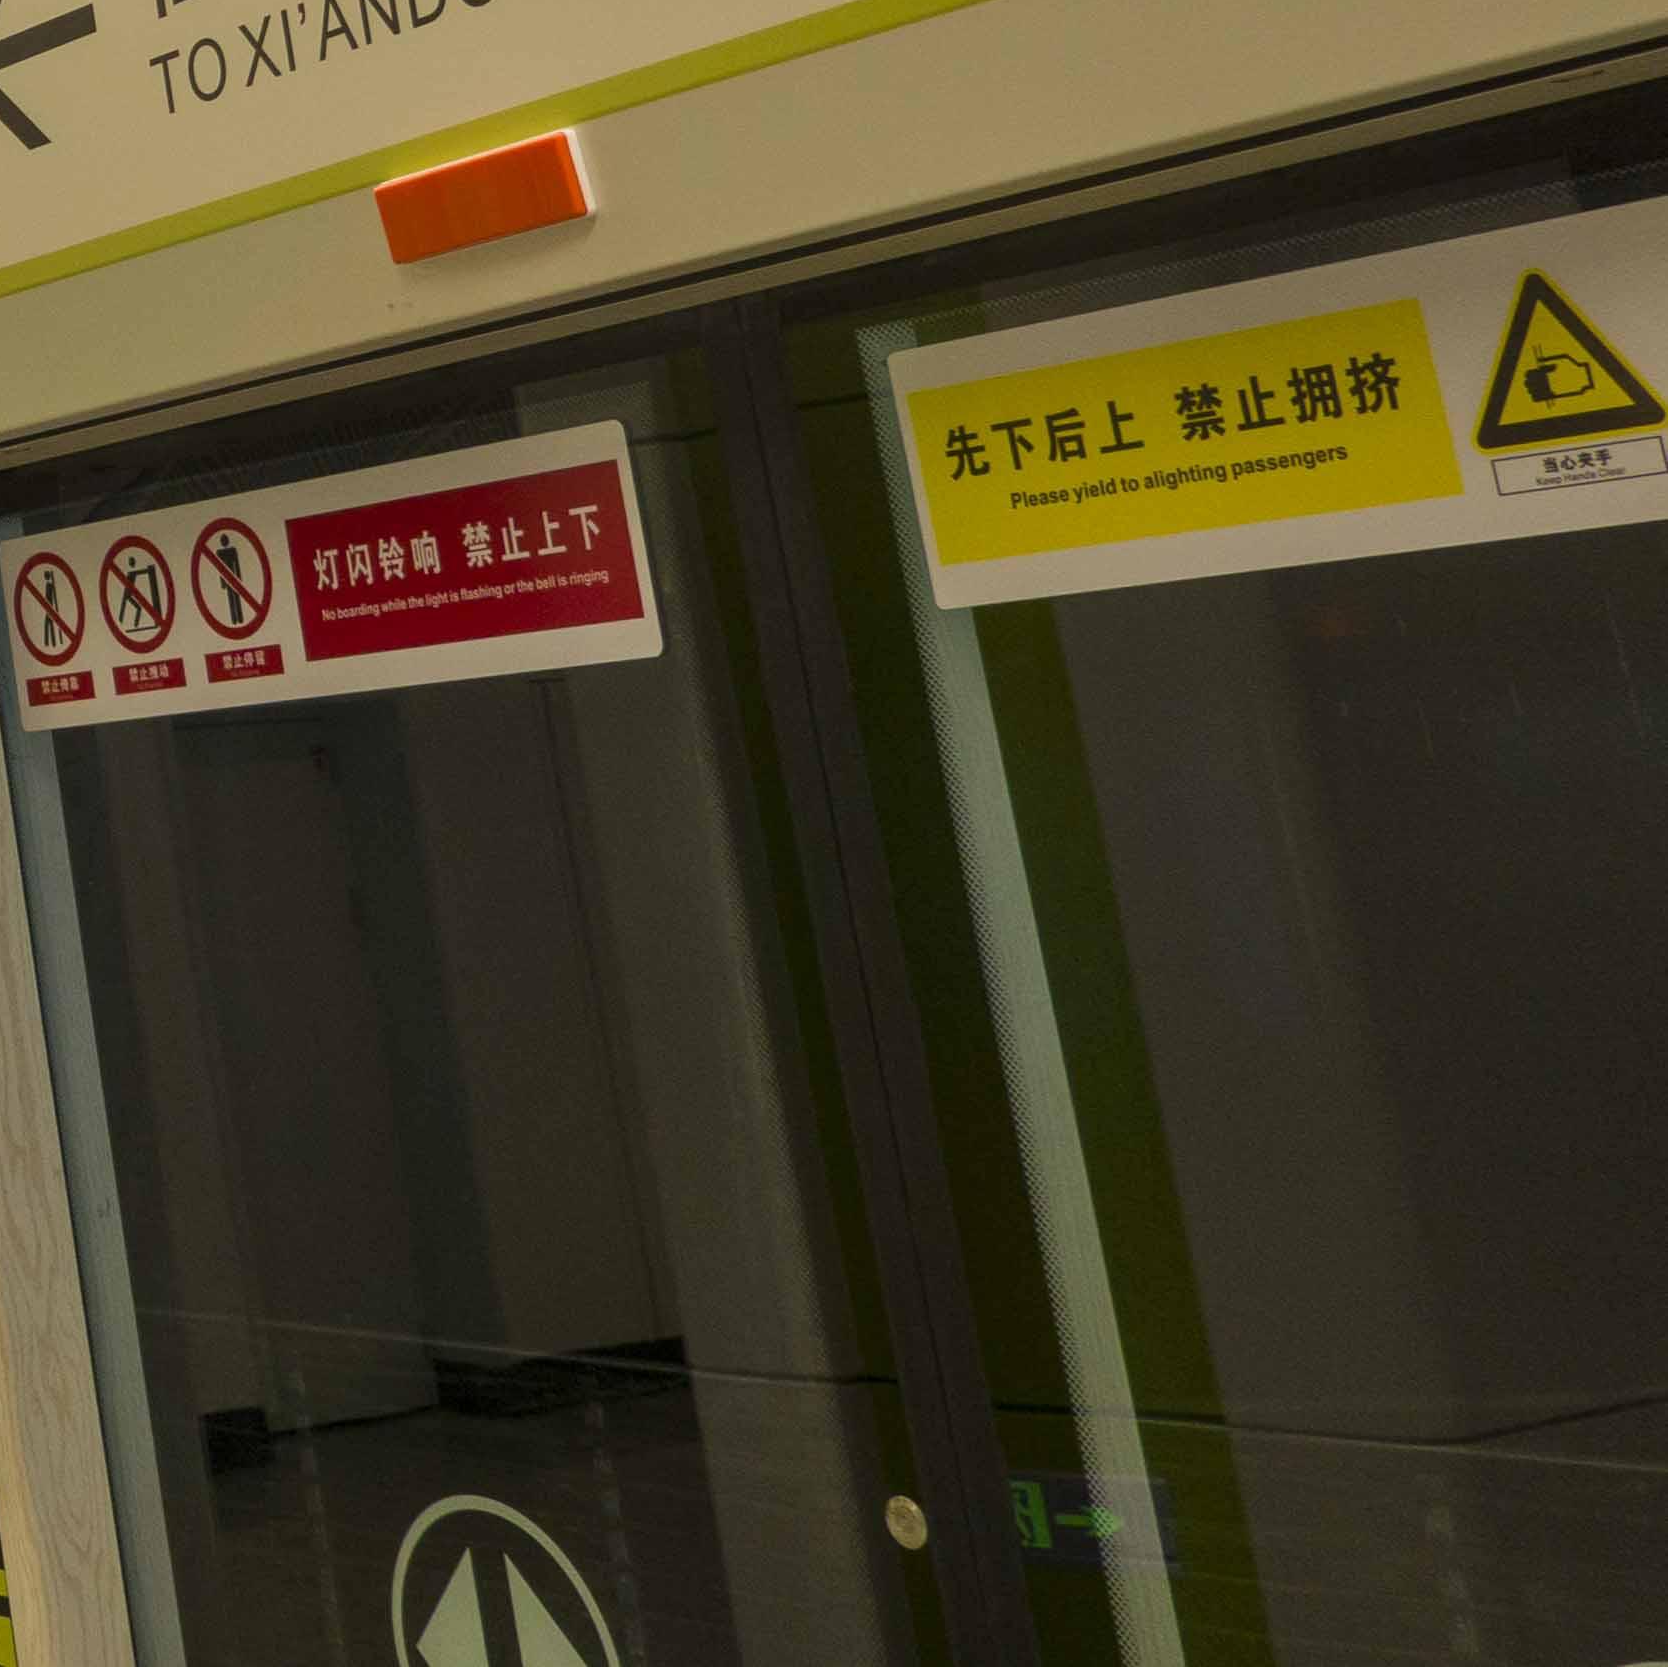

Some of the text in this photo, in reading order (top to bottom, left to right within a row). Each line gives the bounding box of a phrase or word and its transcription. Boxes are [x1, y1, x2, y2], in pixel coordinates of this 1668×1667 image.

[149, 36, 228, 113] TO
[945, 351, 1402, 482] 先下后上 禁止拥挤
[1010, 444, 1348, 510] Please yield to alighting passengers
[1543, 448, 1612, 474] 当心夹手
[313, 504, 600, 591] 灯闪铃响 禁止上下
[322, 569, 609, 621] No boarding while the light is flashing or the bell is ringing
